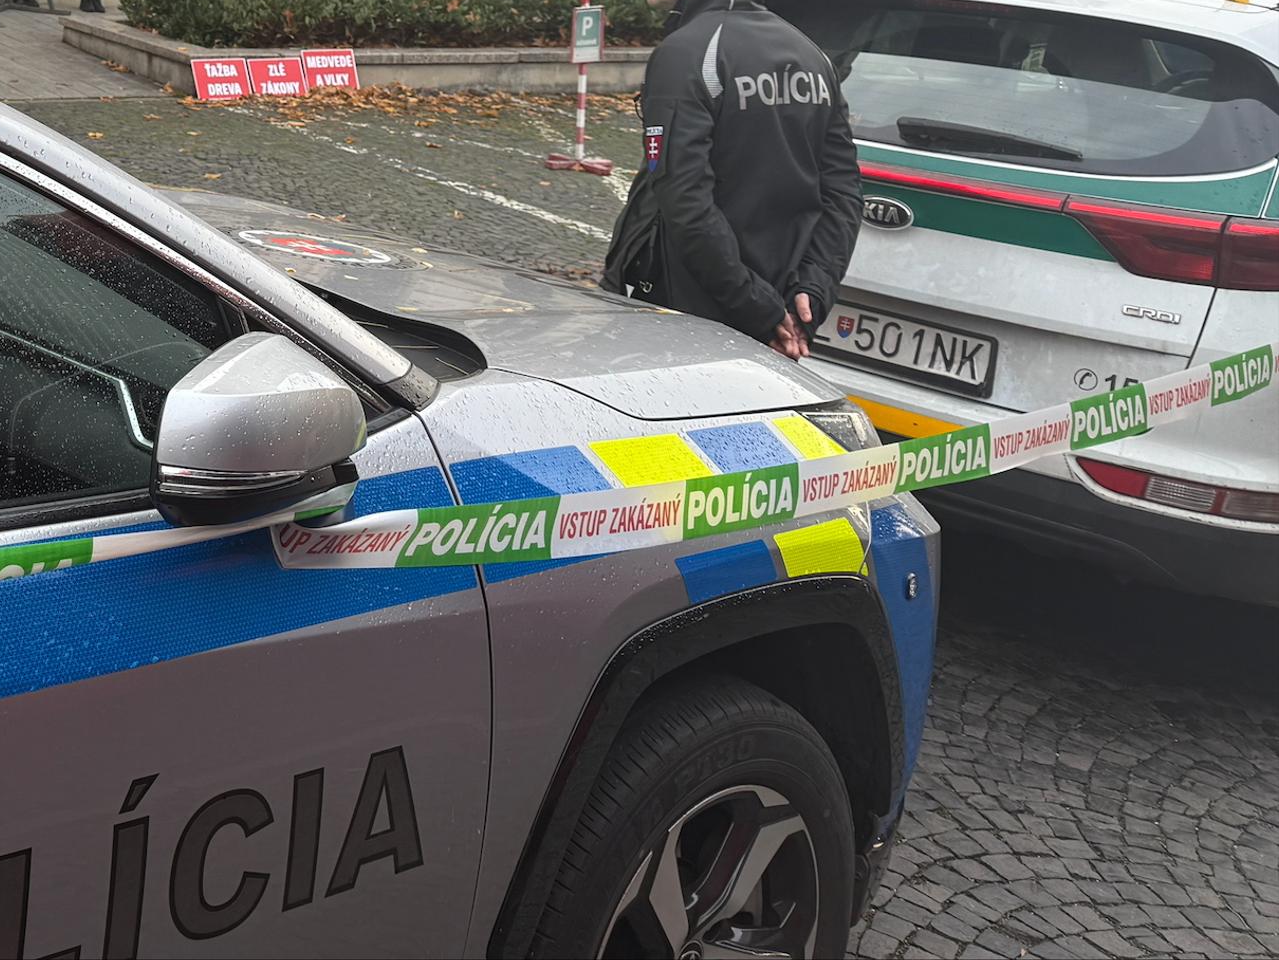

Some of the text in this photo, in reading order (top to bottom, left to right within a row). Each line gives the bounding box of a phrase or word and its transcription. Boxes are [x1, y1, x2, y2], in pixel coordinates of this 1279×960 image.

[581, 16, 594, 37] P
[306, 54, 353, 69] MEDVEDE
[208, 82, 243, 96] DREVA
[324, 73, 349, 87] VLKY
[734, 64, 832, 111] POLÍCIA
[864, 202, 901, 225] KIA
[854, 314, 984, 380] 501NK
[306, 524, 412, 554] ZAKÁZANÝ
[405, 503, 548, 557] POLÍCIA
[558, 509, 607, 540] VSTUP
[609, 493, 681, 534] ZAKÁZANÝ
[686, 472, 793, 530] POLÍCIA
[802, 472, 840, 503] VSTUP
[840, 456, 898, 496] ZAKÁZANÝ
[899, 433, 988, 486] POLÍCIA
[993, 431, 1024, 460] VSTUP
[1024, 414, 1071, 451] ZAKÁZANÝ
[1073, 389, 1146, 442] POLÍCIA
[1148, 392, 1174, 416] VSTUP
[1175, 373, 1212, 408] ZAKÁZANÝ
[1213, 351, 1271, 400] POLÍCIA
